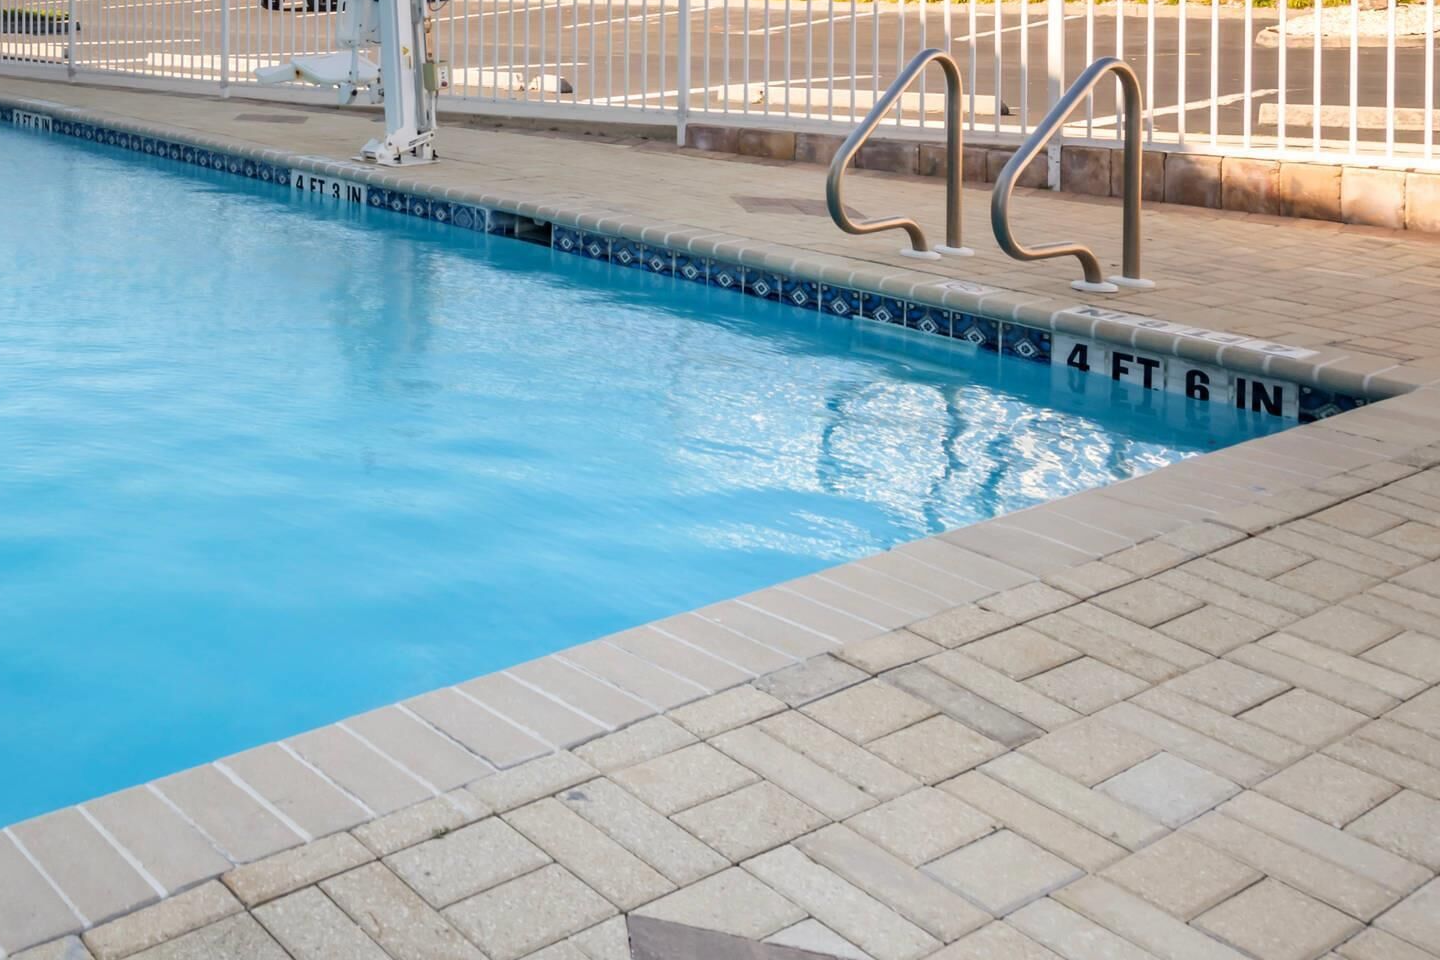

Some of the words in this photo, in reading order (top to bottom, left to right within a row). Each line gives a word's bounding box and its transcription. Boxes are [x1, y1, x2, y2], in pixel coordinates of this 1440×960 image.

[296, 174, 304, 190] 4
[310, 177, 325, 194] FT
[332, 182, 340, 199] 3
[347, 185, 361, 203] IN
[1067, 343, 1090, 373] 4
[1112, 351, 1160, 390] FT
[1185, 369, 1210, 402] 6
[1236, 377, 1283, 417] IN
